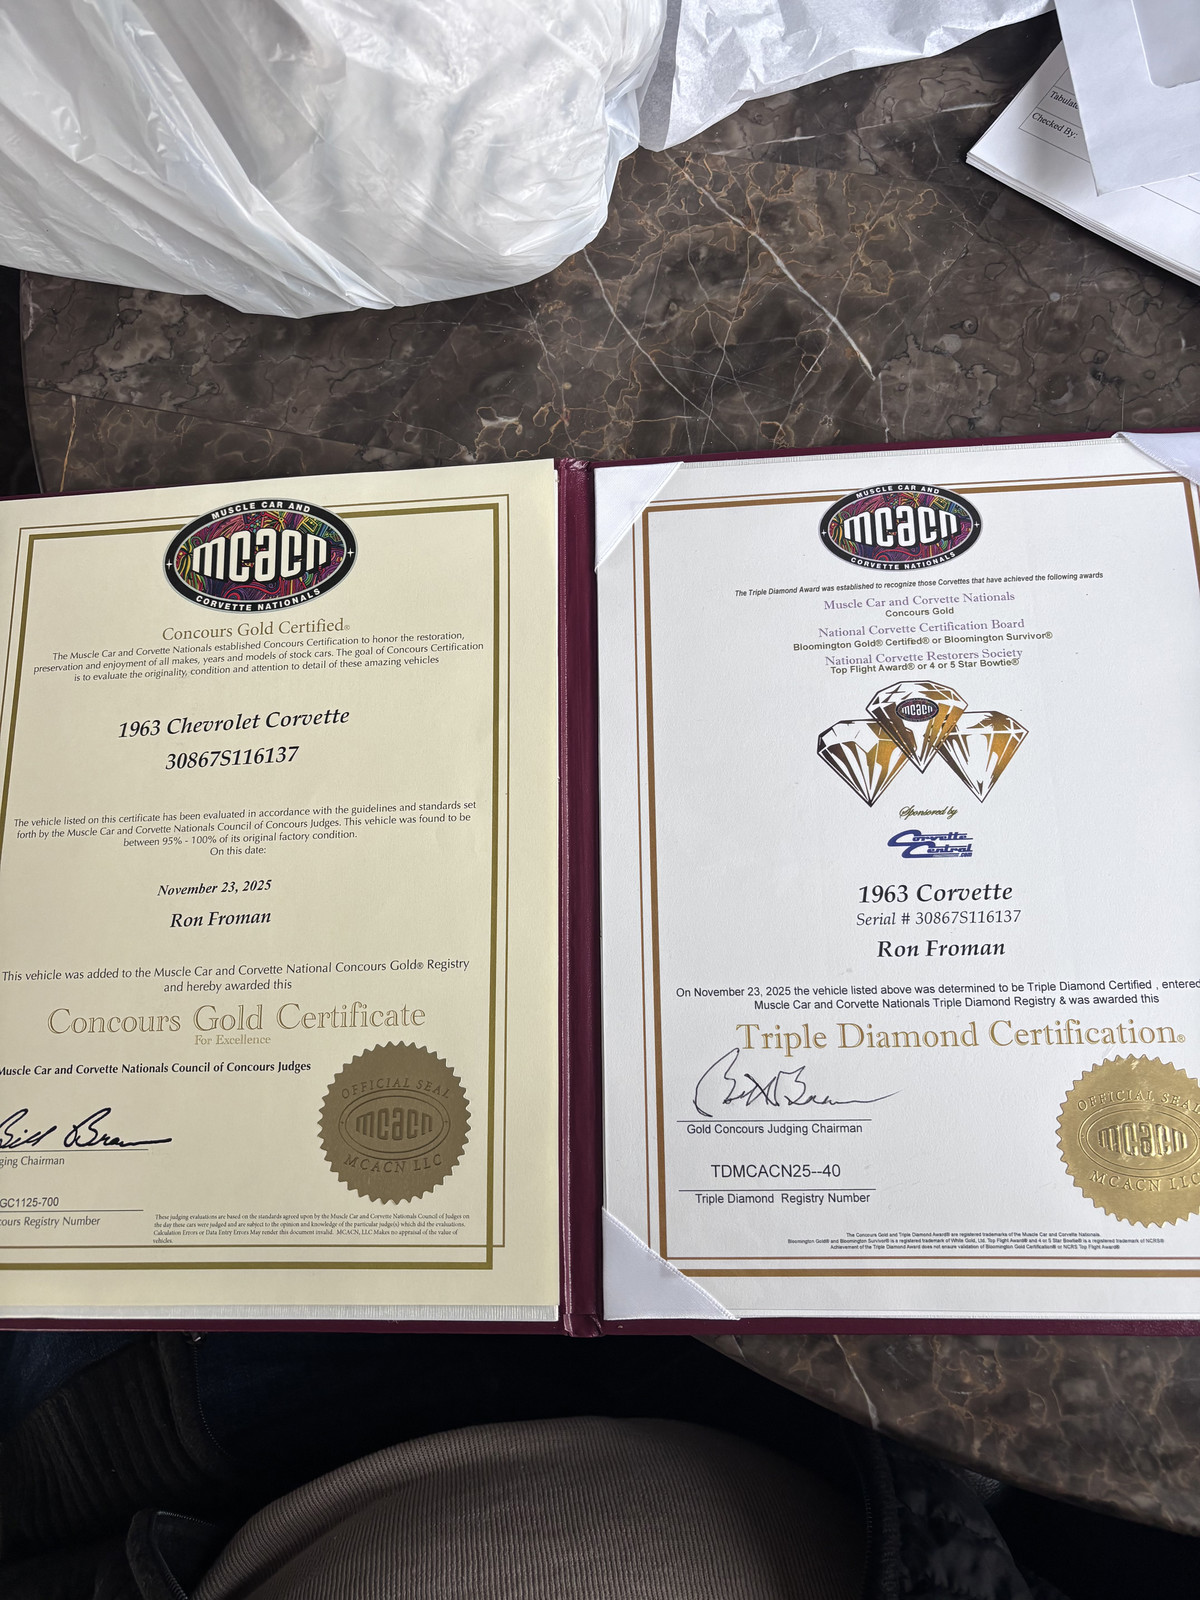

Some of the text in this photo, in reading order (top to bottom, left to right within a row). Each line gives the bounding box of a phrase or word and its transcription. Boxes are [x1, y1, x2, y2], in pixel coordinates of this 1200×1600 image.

[1032, 112, 1078, 139] Checked By:
[856, 485, 893, 499] MUSCLE
[921, 486, 940, 495] AND
[211, 501, 311, 520] MUSCLE CAR AND
[850, 551, 955, 570] CORVETTE NATIONALS
[196, 588, 321, 611] CORVETTE NATIONALS
[823, 591, 1015, 610] Muscle Car and Corvette Nationals
[885, 606, 954, 617] Concours Gold
[162, 627, 232, 640] Concours
[237, 620, 273, 636] Gold
[818, 618, 1024, 637] National Corvette Certification Board
[793, 641, 851, 651] Bloomington
[943, 634, 1004, 643] Bloomington
[825, 649, 1023, 665] National Corvette Restorers Society
[830, 666, 847, 675] Top
[849, 664, 876, 674] Flight
[929, 661, 935, 669] 4
[950, 660, 955, 668] 5
[957, 659, 977, 668] Star
[118, 708, 349, 737] 1963 Chevrolet Corvette
[165, 745, 299, 770] 30867S116137
[899, 805, 958, 820] Sponsored by
[123, 837, 159, 846] between
[162, 836, 182, 845] 95%
[191, 834, 217, 844] 100%
[218, 833, 229, 843] of
[230, 833, 240, 843] its
[241, 831, 276, 844] original
[278, 831, 310, 842] factory
[311, 829, 357, 839] condition.
[887, 829, 973, 847] Corvette
[209, 845, 266, 855] On this date:
[901, 841, 973, 858] Central
[157, 879, 272, 896] November 23, 2025
[859, 883, 1012, 903] 1963 Corvette
[170, 911, 271, 927] Ron Froman
[856, 909, 1021, 926] Serial # 30867S116137
[876, 939, 1005, 957] Ron Froman
[1, 970, 22, 981] This
[25, 969, 62, 980] vehicle
[64, 971, 84, 979] was
[86, 967, 119, 979] added
[121, 969, 132, 978] to
[134, 966, 151, 977] the
[153, 965, 191, 977] Muscle
[193, 965, 213, 976] Car
[215, 964, 235, 976] and
[238, 964, 283, 975] Corvette
[286, 961, 331, 974] National
[335, 961, 386, 972] Concours
[427, 958, 469, 972] Registry
[163, 978, 292, 994] and hereby awarded this
[675, 987, 691, 997] On
[694, 987, 744, 997] November
[747, 986, 762, 997] 23,
[765, 986, 791, 996] 2025
[793, 986, 809, 995] the
[812, 985, 848, 995] vehicle
[850, 985, 877, 995] listed
[880, 984, 911, 994] above
[937, 982, 995, 993] determined
[998, 983, 1008, 992] to
[1011, 982, 1024, 992] be
[1026, 981, 1056, 993] Triple
[1059, 980, 1105, 991] Diamond
[1108, 979, 1152, 990] Certified
[47, 1000, 425, 1034] Concours Gold Certificate
[194, 1032, 271, 1045] For Excellence
[733, 1022, 827, 1058] Triple
[835, 1020, 979, 1048] Diamond
[33, 1065, 52, 1075] Car
[54, 1063, 73, 1074] and
[75, 1064, 118, 1074] Corvette
[121, 1062, 168, 1073] Nationals
[171, 1061, 210, 1072] Council
[213, 1061, 224, 1072] of
[226, 1061, 274, 1072] Concours
[277, 1060, 311, 1074] Judges
[341, 1077, 450, 1099] OFFICIAL SEAL
[1077, 1090, 1155, 1112] OFFICIAL
[686, 1122, 862, 1136] Gold Concours Judging Chairman
[20, 1155, 64, 1165] Chairman
[343, 1154, 442, 1173] MCACN LLC
[710, 1163, 840, 1178] TDMCACN25--40
[1089, 1170, 1200, 1192] MCACN LLC
[0, 1196, 59, 1208] GC1125-700
[694, 1192, 870, 1206] Triple Diamond Registry Number
[0, 1215, 100, 1229] cours Registry Number
